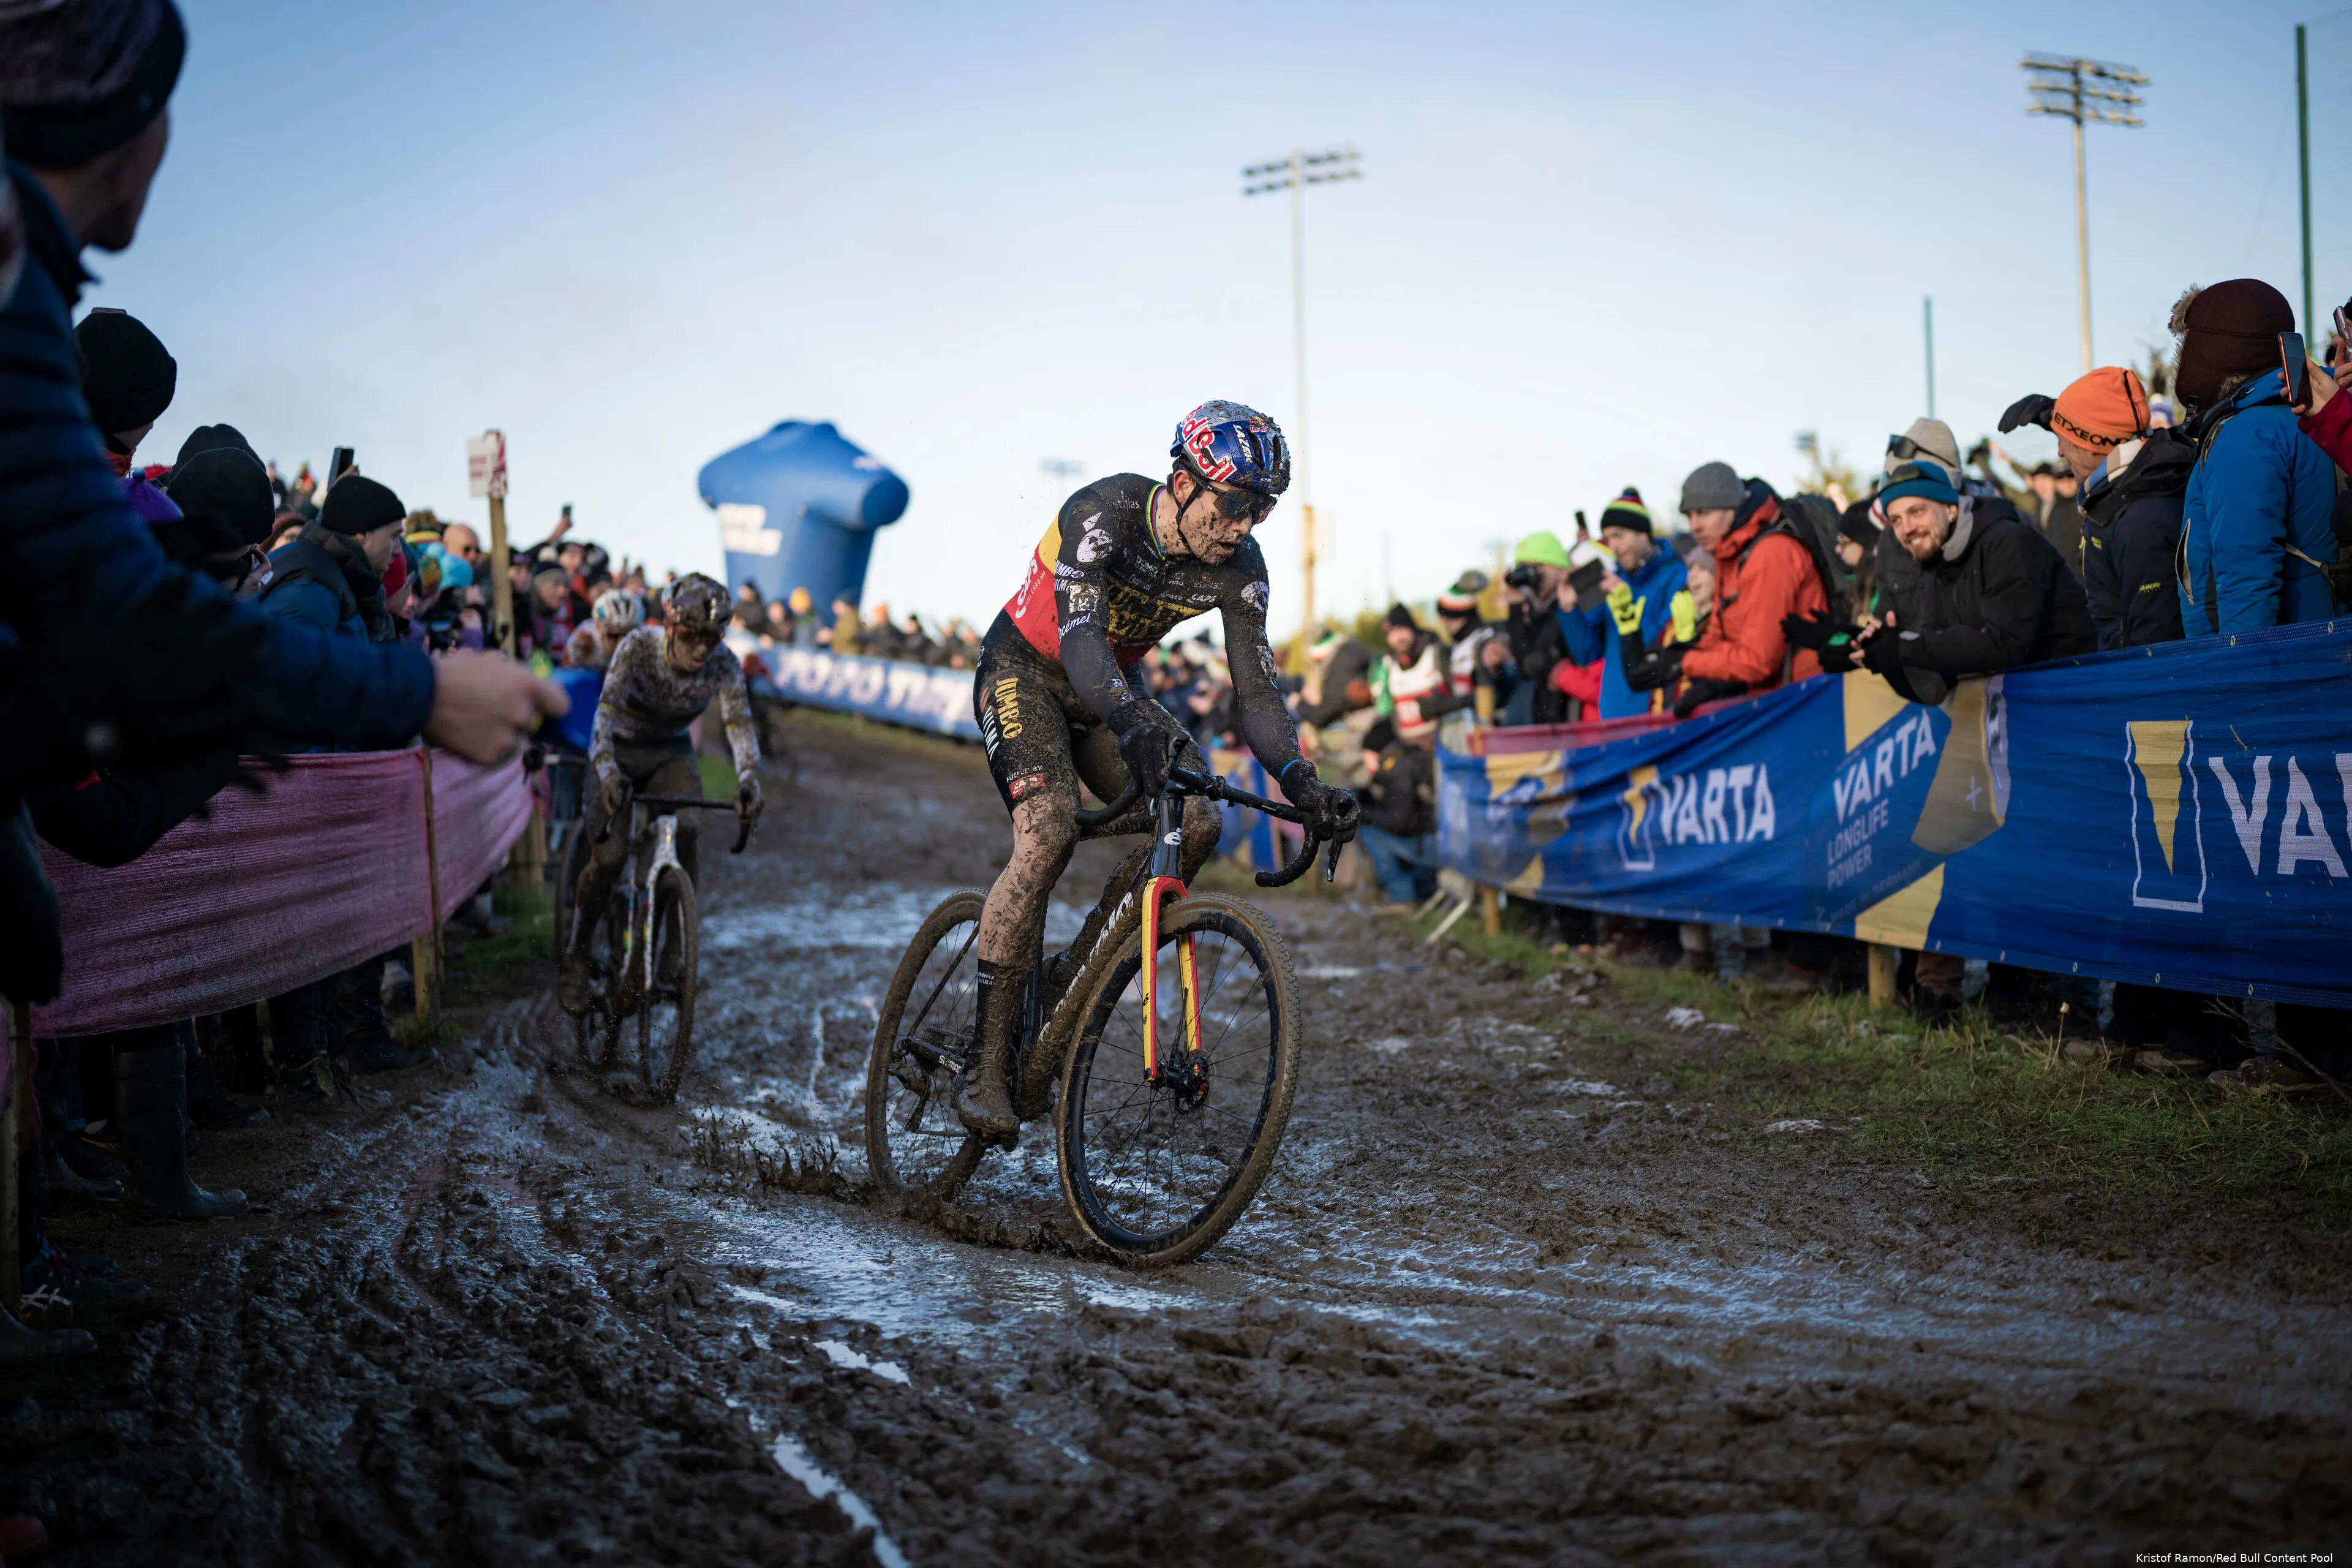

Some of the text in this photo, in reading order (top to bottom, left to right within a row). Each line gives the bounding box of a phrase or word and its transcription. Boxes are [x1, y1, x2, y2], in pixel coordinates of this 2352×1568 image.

[1187, 426, 1237, 483] Bull
[1189, 594, 1217, 604] CAPS
[995, 677, 1023, 739] JUMBO
[1833, 708, 1936, 824] VARTA
[1655, 763, 1774, 845] VARTA
[1827, 799, 1889, 866] LONGLIFE
[1827, 844, 1872, 891] POWER
